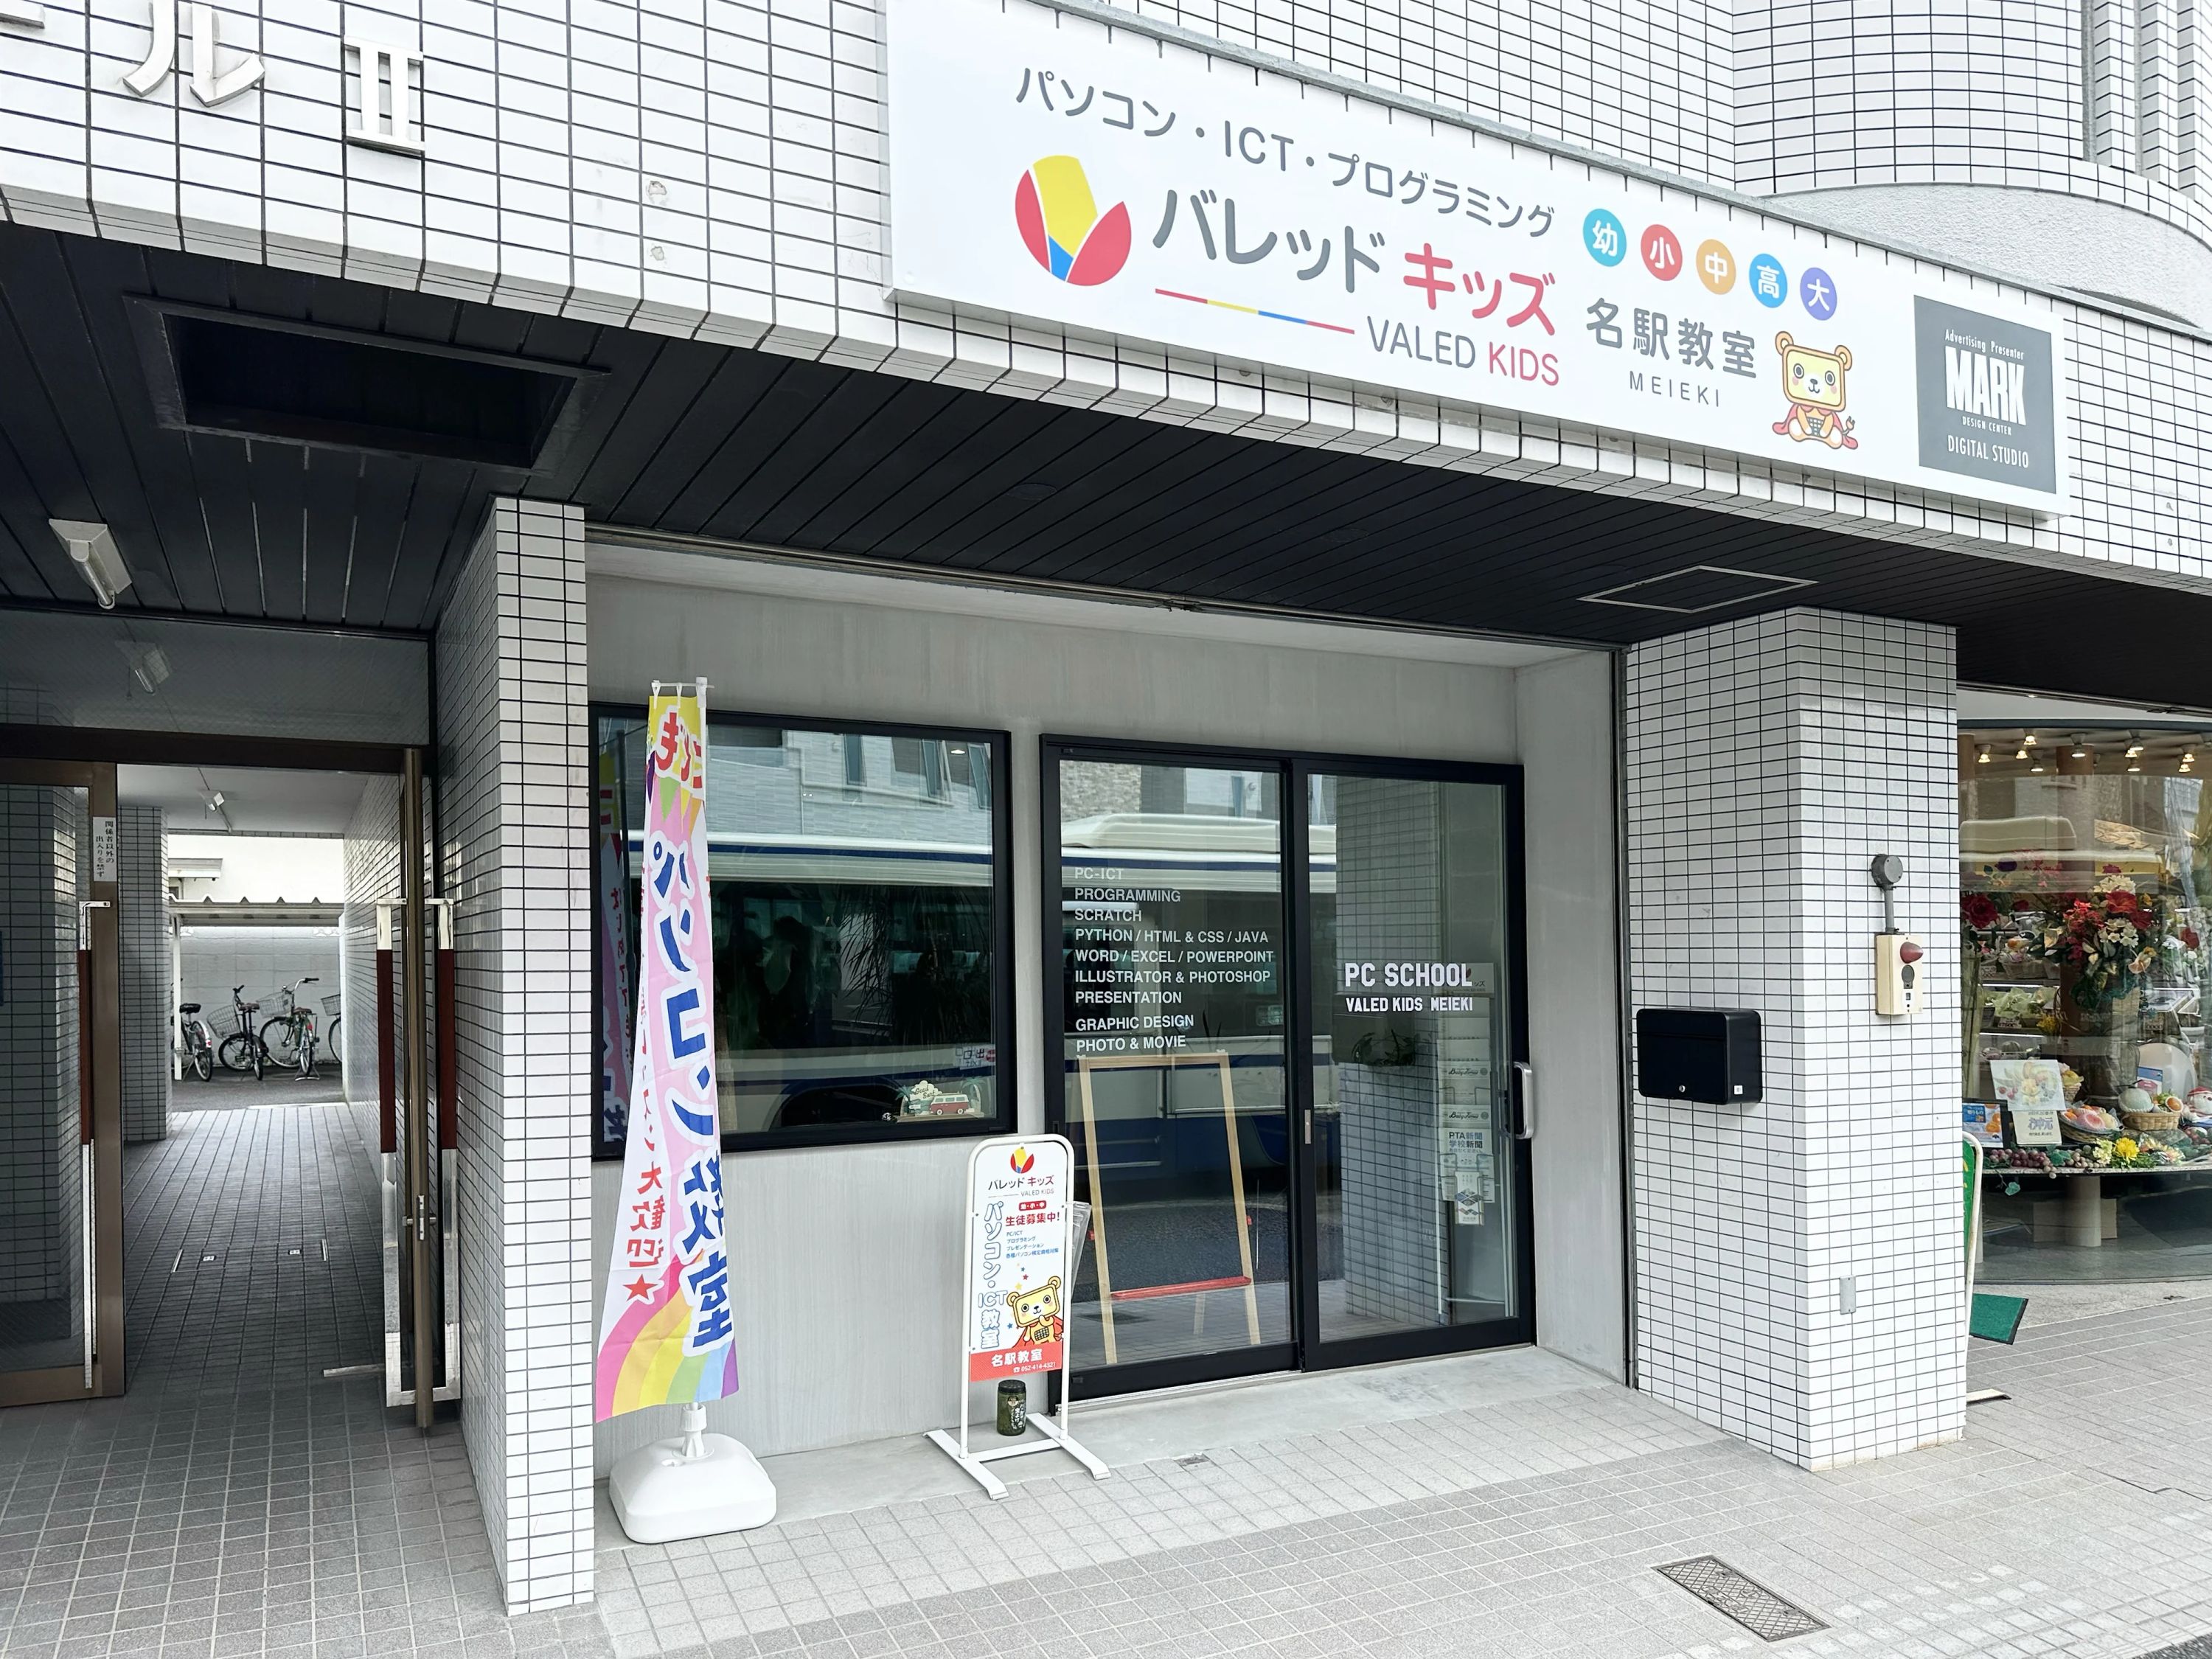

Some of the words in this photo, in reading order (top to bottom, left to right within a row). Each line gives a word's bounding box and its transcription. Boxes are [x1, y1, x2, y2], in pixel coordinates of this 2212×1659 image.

[1016, 67, 1554, 238] パソコン・ICT・プログラミング
[1153, 188, 1386, 293] バレッド
[1402, 242, 1557, 335] キッズ
[1592, 220, 1618, 257] 幼
[1648, 235, 1675, 269] 小
[1704, 251, 1728, 284] 中
[1756, 265, 1780, 299] 高
[1806, 279, 1830, 311] 大
[1586, 296, 1757, 379] 名駅教室
[1945, 329, 1986, 353] Advertising
[1990, 341, 2025, 361] Presenter
[1367, 315, 1476, 369] VALED
[1489, 341, 1560, 386] KIDS
[1629, 369, 1721, 408] MEIEKI
[1944, 345, 2027, 426] MARK
[1962, 416, 1986, 430] DESIGN
[1989, 422, 2012, 436] CENTER
[1947, 434, 1989, 460] DIGITAL
[1992, 444, 2029, 468] STUDIO
[1074, 888, 1180, 902] PROGRAMMING
[1074, 908, 1142, 922] SCRATCH
[1075, 928, 1133, 942] PYTHON
[1144, 930, 1181, 942] HTML
[1185, 931, 1194, 943] &
[1197, 931, 1224, 943] CSS
[1234, 931, 1268, 943] JAVA
[1075, 949, 1119, 962] WORD
[1130, 950, 1175, 963] EXCEL
[1186, 950, 1273, 963] POWERPOINT
[1075, 970, 1172, 984] ILLUSTRATOR
[1175, 971, 1184, 984] &
[1189, 970, 1270, 984] PHOTOSHOP
[1345, 962, 1376, 987] PC
[1384, 962, 1473, 987] SCHOOL
[1075, 991, 1182, 1004] PRESENTATION
[1346, 997, 1388, 1012] VALED
[1392, 997, 1423, 1012] KIDS
[1430, 996, 1473, 1012] MEIEKI
[1076, 1016, 1139, 1032] GRAPHIC
[1144, 1015, 1194, 1029] DESIGN
[1077, 1037, 1125, 1052] PHOTO
[1130, 1037, 1139, 1050] &
[1144, 1035, 1186, 1048] MOVIE
[988, 1177, 1025, 1191] バレッド
[1027, 1175, 1054, 1186] キッズ
[991, 1348, 1043, 1368] 名駅教室
